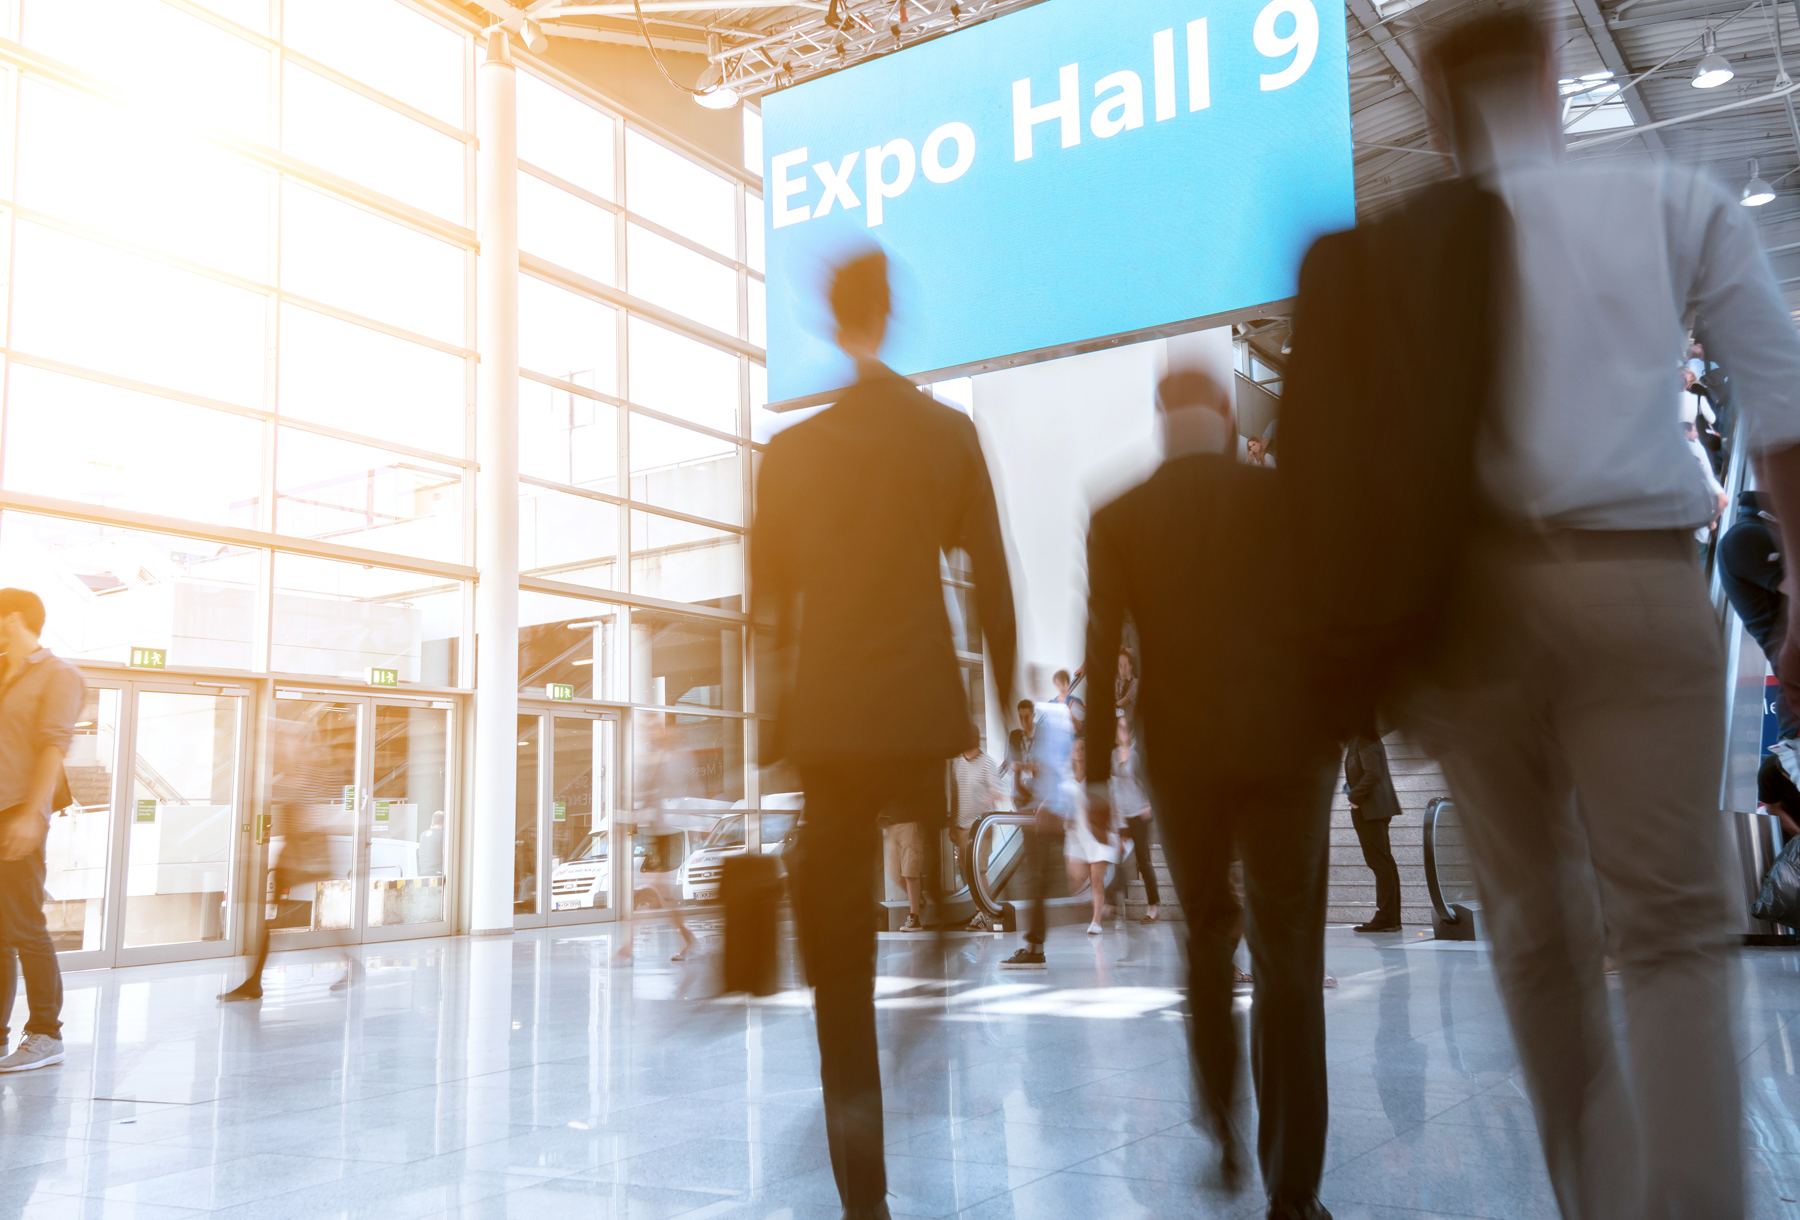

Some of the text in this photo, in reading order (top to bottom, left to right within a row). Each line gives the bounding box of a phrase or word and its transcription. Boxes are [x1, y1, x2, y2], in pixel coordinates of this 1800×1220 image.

[771, 0, 1320, 230] Expo Hall 9
